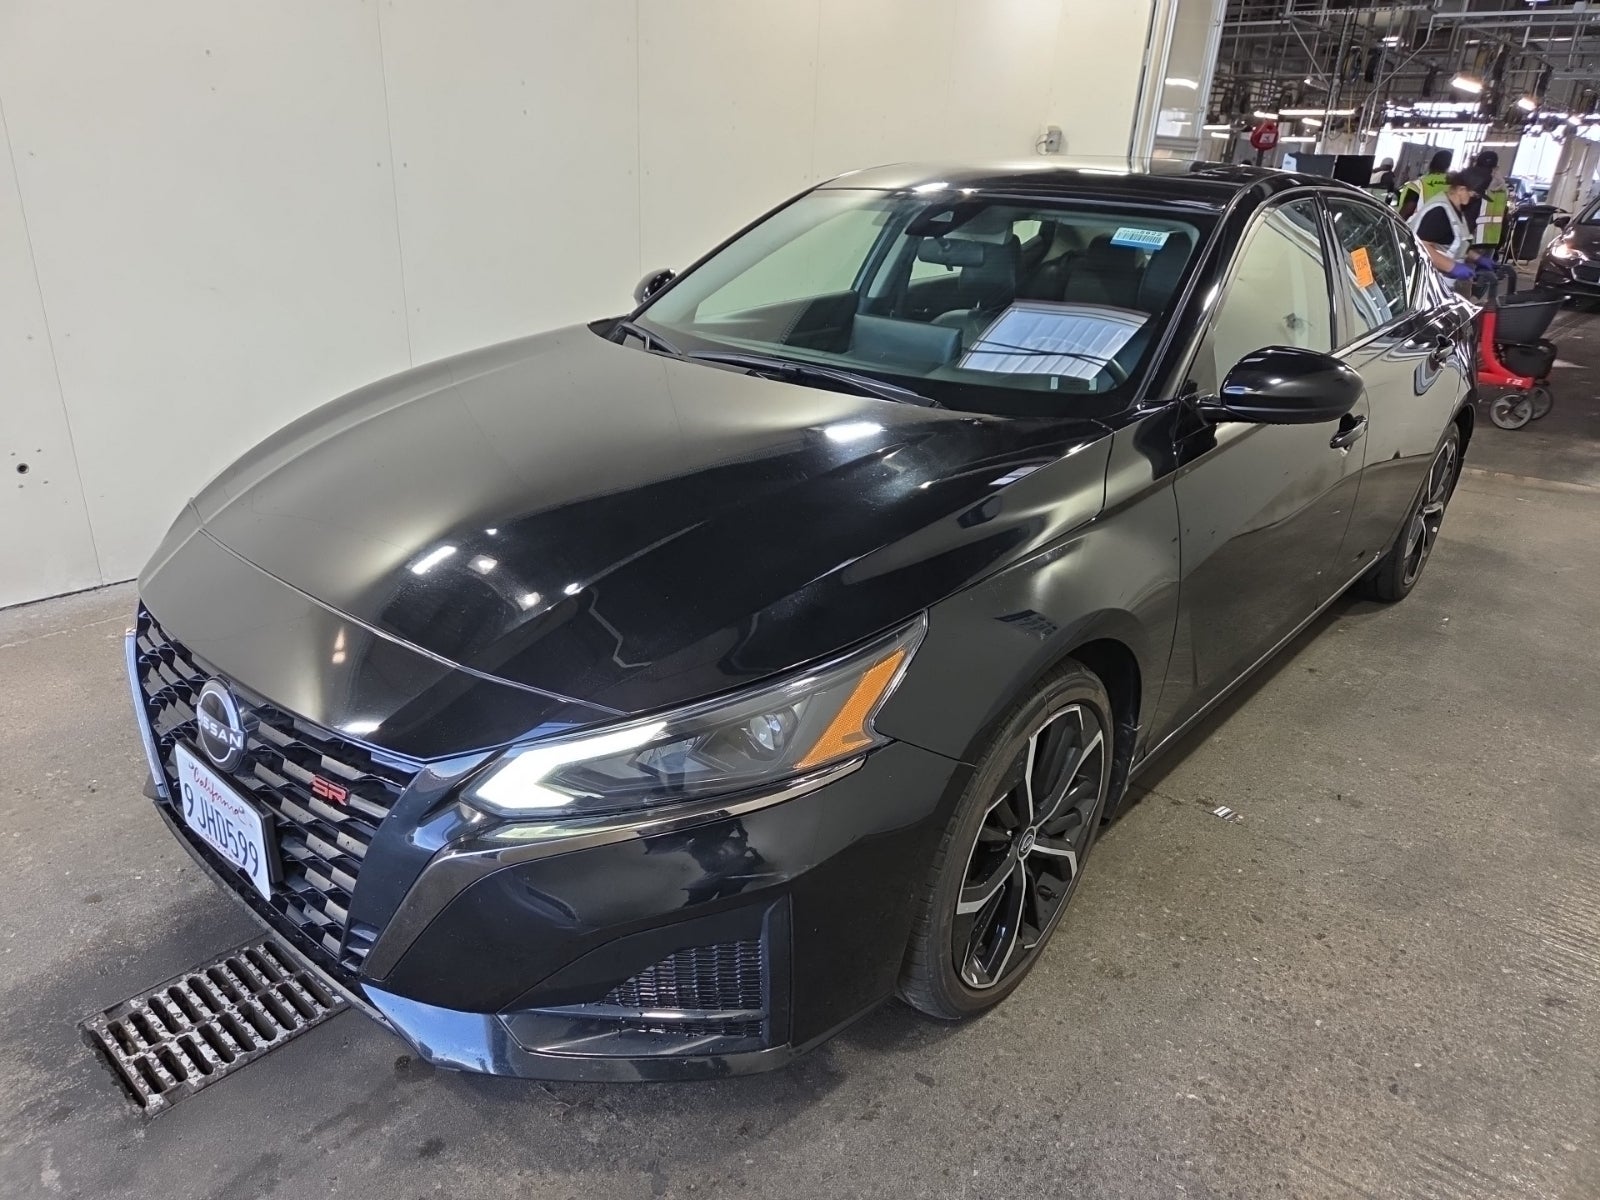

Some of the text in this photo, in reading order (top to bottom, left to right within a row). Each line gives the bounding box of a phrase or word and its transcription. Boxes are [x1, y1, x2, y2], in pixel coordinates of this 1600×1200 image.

[200, 712, 243, 748] SSAN
[190, 765, 243, 816] California
[312, 776, 347, 806] SR
